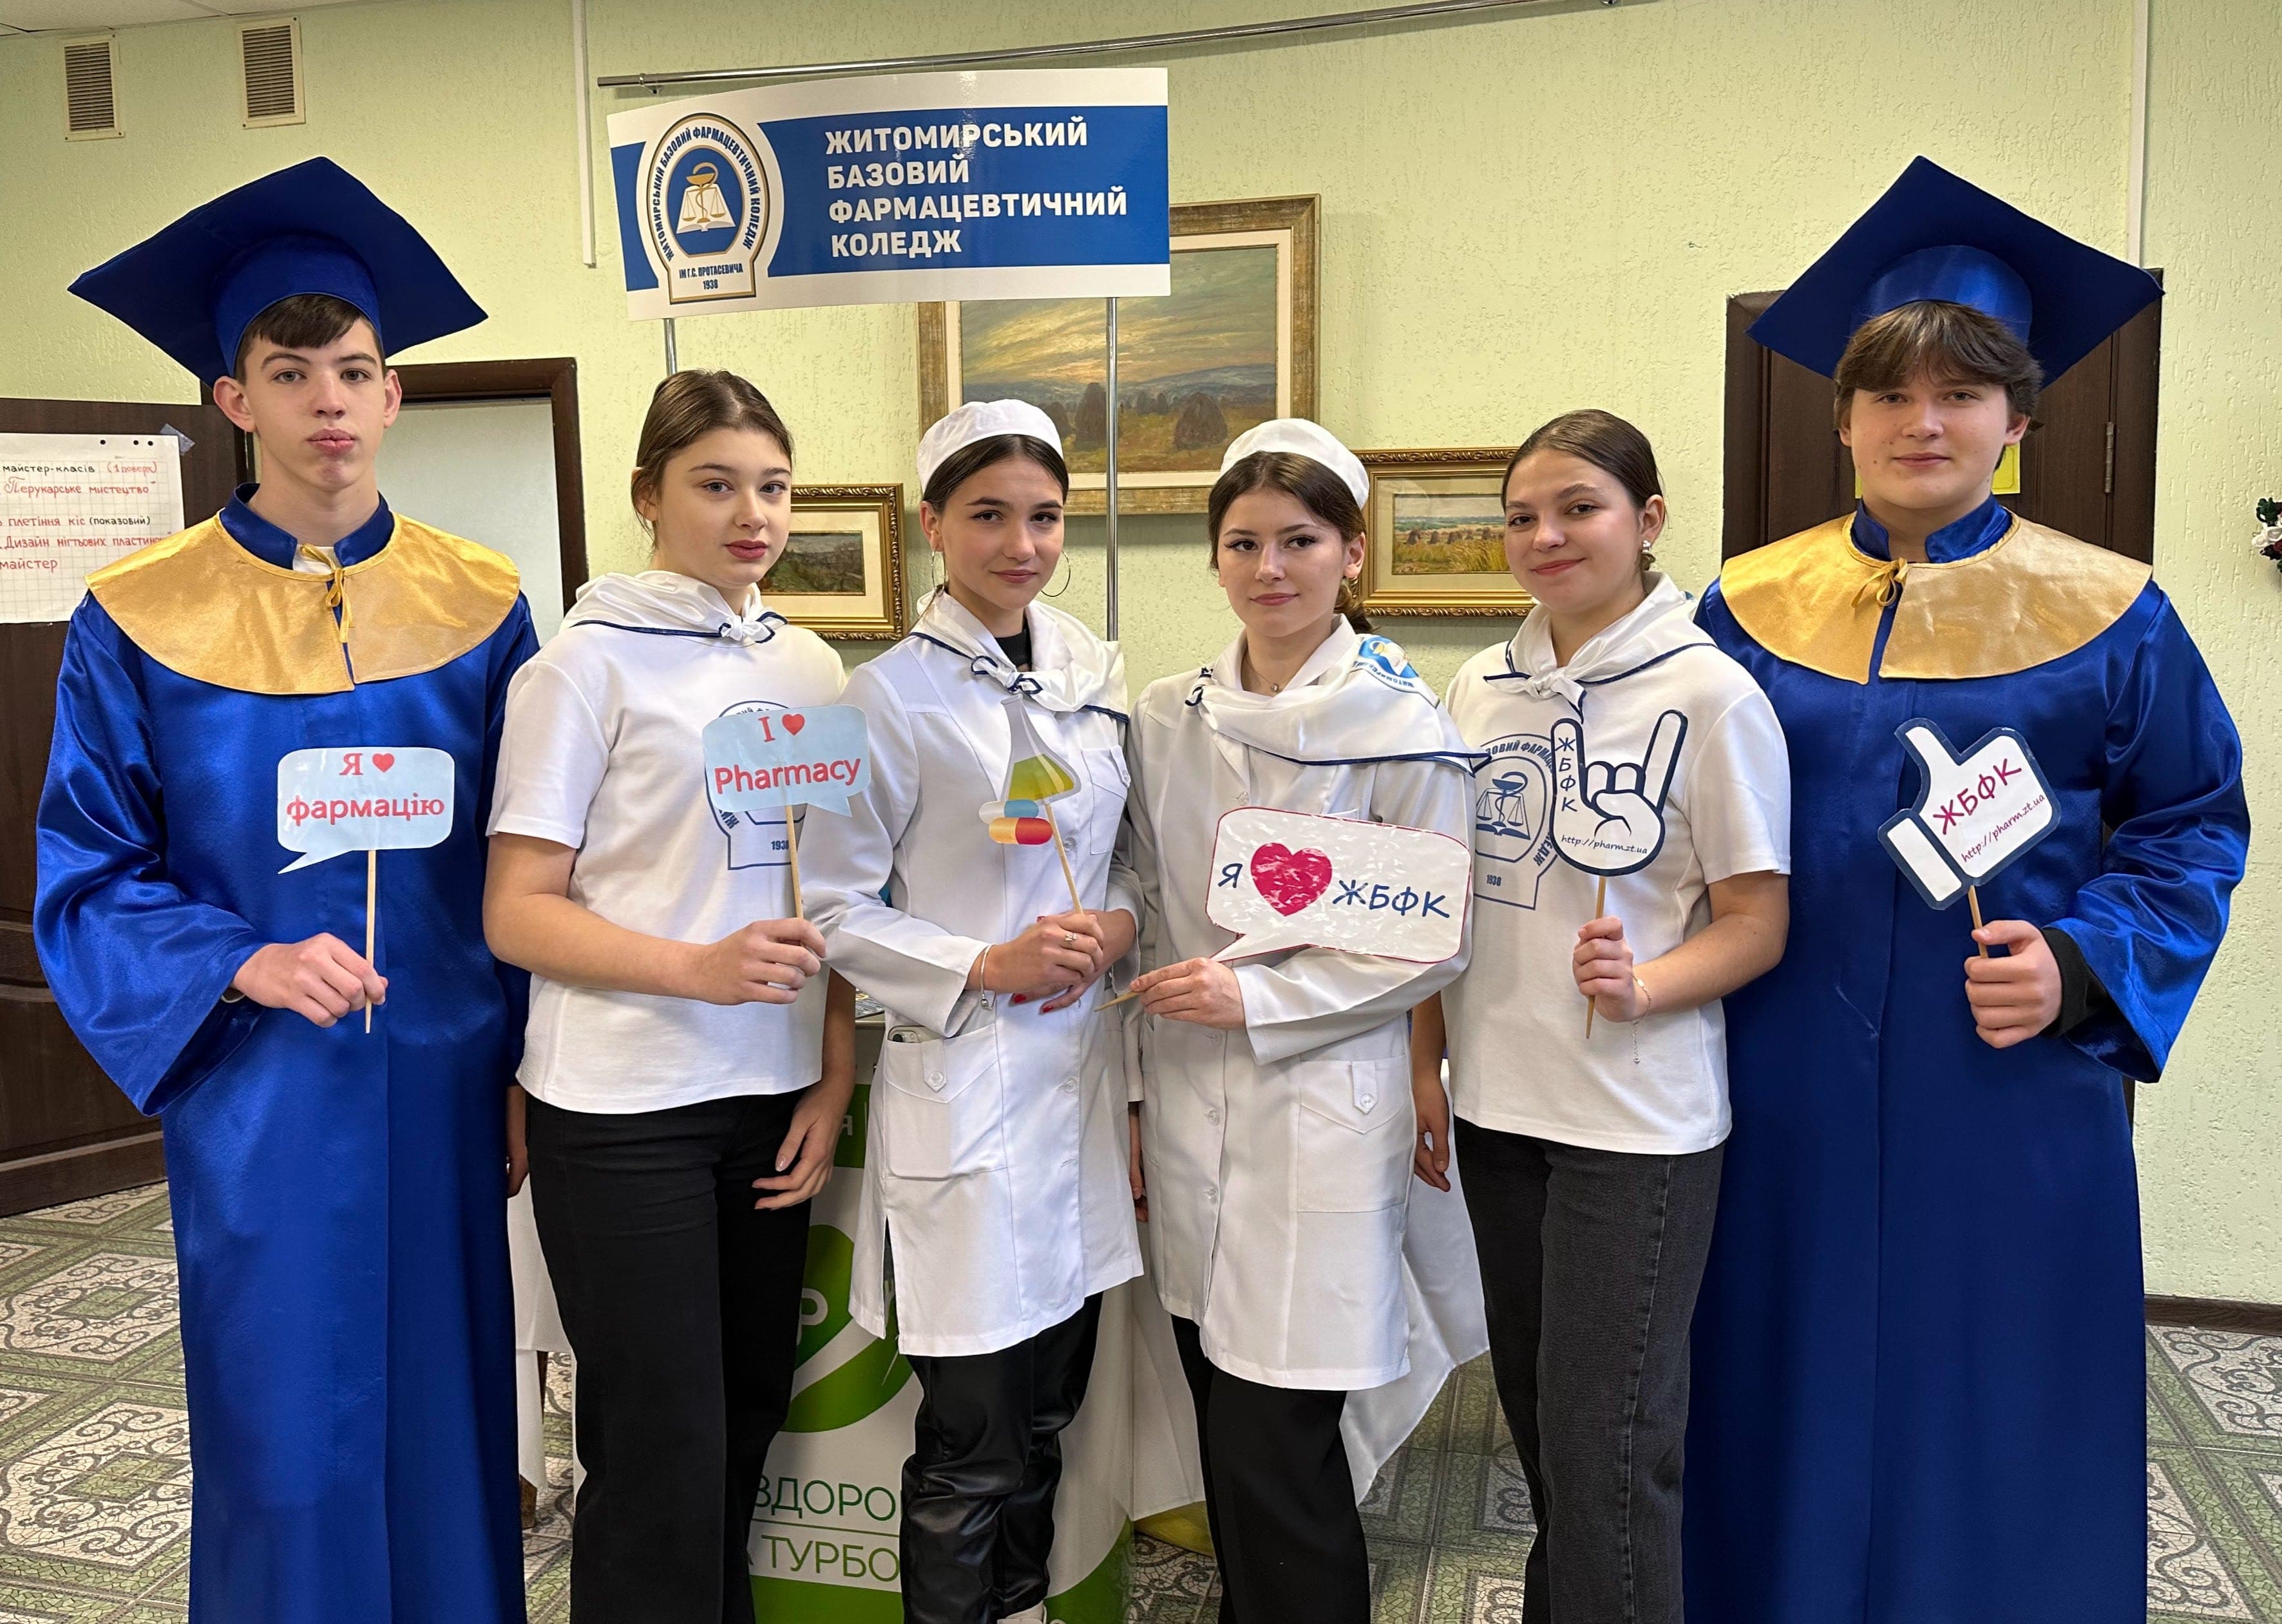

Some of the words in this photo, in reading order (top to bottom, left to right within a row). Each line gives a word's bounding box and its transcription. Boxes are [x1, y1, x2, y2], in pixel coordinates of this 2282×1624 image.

[660, 127, 692, 168] БАЗОВИЙ
[825, 115, 1087, 155] ЖИТОМИРСЬКИЙ
[693, 126, 763, 196] ФАРМАЦЕВТИЧНИЙ
[828, 153, 969, 189] БАЗОВИЙ
[652, 166, 674, 262] ЖИТОМИРСЬКИЙ
[829, 185, 1127, 223] ФАРМАЦЕВТИЧНИЙ
[743, 197, 761, 250] КОЛЕДЖ
[831, 230, 962, 258] КОЛЕДЖ
[698, 263, 743, 277] ПРОТАСЕВИЧА
[703, 279, 718, 290] 1938
[3, 464, 95, 476] майстер-класів
[8, 516, 61, 526] плетіння
[68, 515, 86, 525] кіс
[5, 536, 50, 549] Дизайн
[0, 558, 57, 573] майстер
[758, 715, 775, 742] I
[338, 753, 363, 775] Я
[714, 758, 861, 794] Pharmacy
[286, 793, 444, 827] фармацію
[1933, 759, 2022, 835] ЖБФК
[1561, 835, 1648, 854] http://pharm.zt.ua
[1961, 795, 2046, 862] http://pharm.zt.ua
[1217, 863, 1243, 889] Я
[1332, 880, 1450, 918] ЖБФК
[1487, 874, 1501, 886] 1938
[754, 1474, 897, 1521] ЗДОРО
